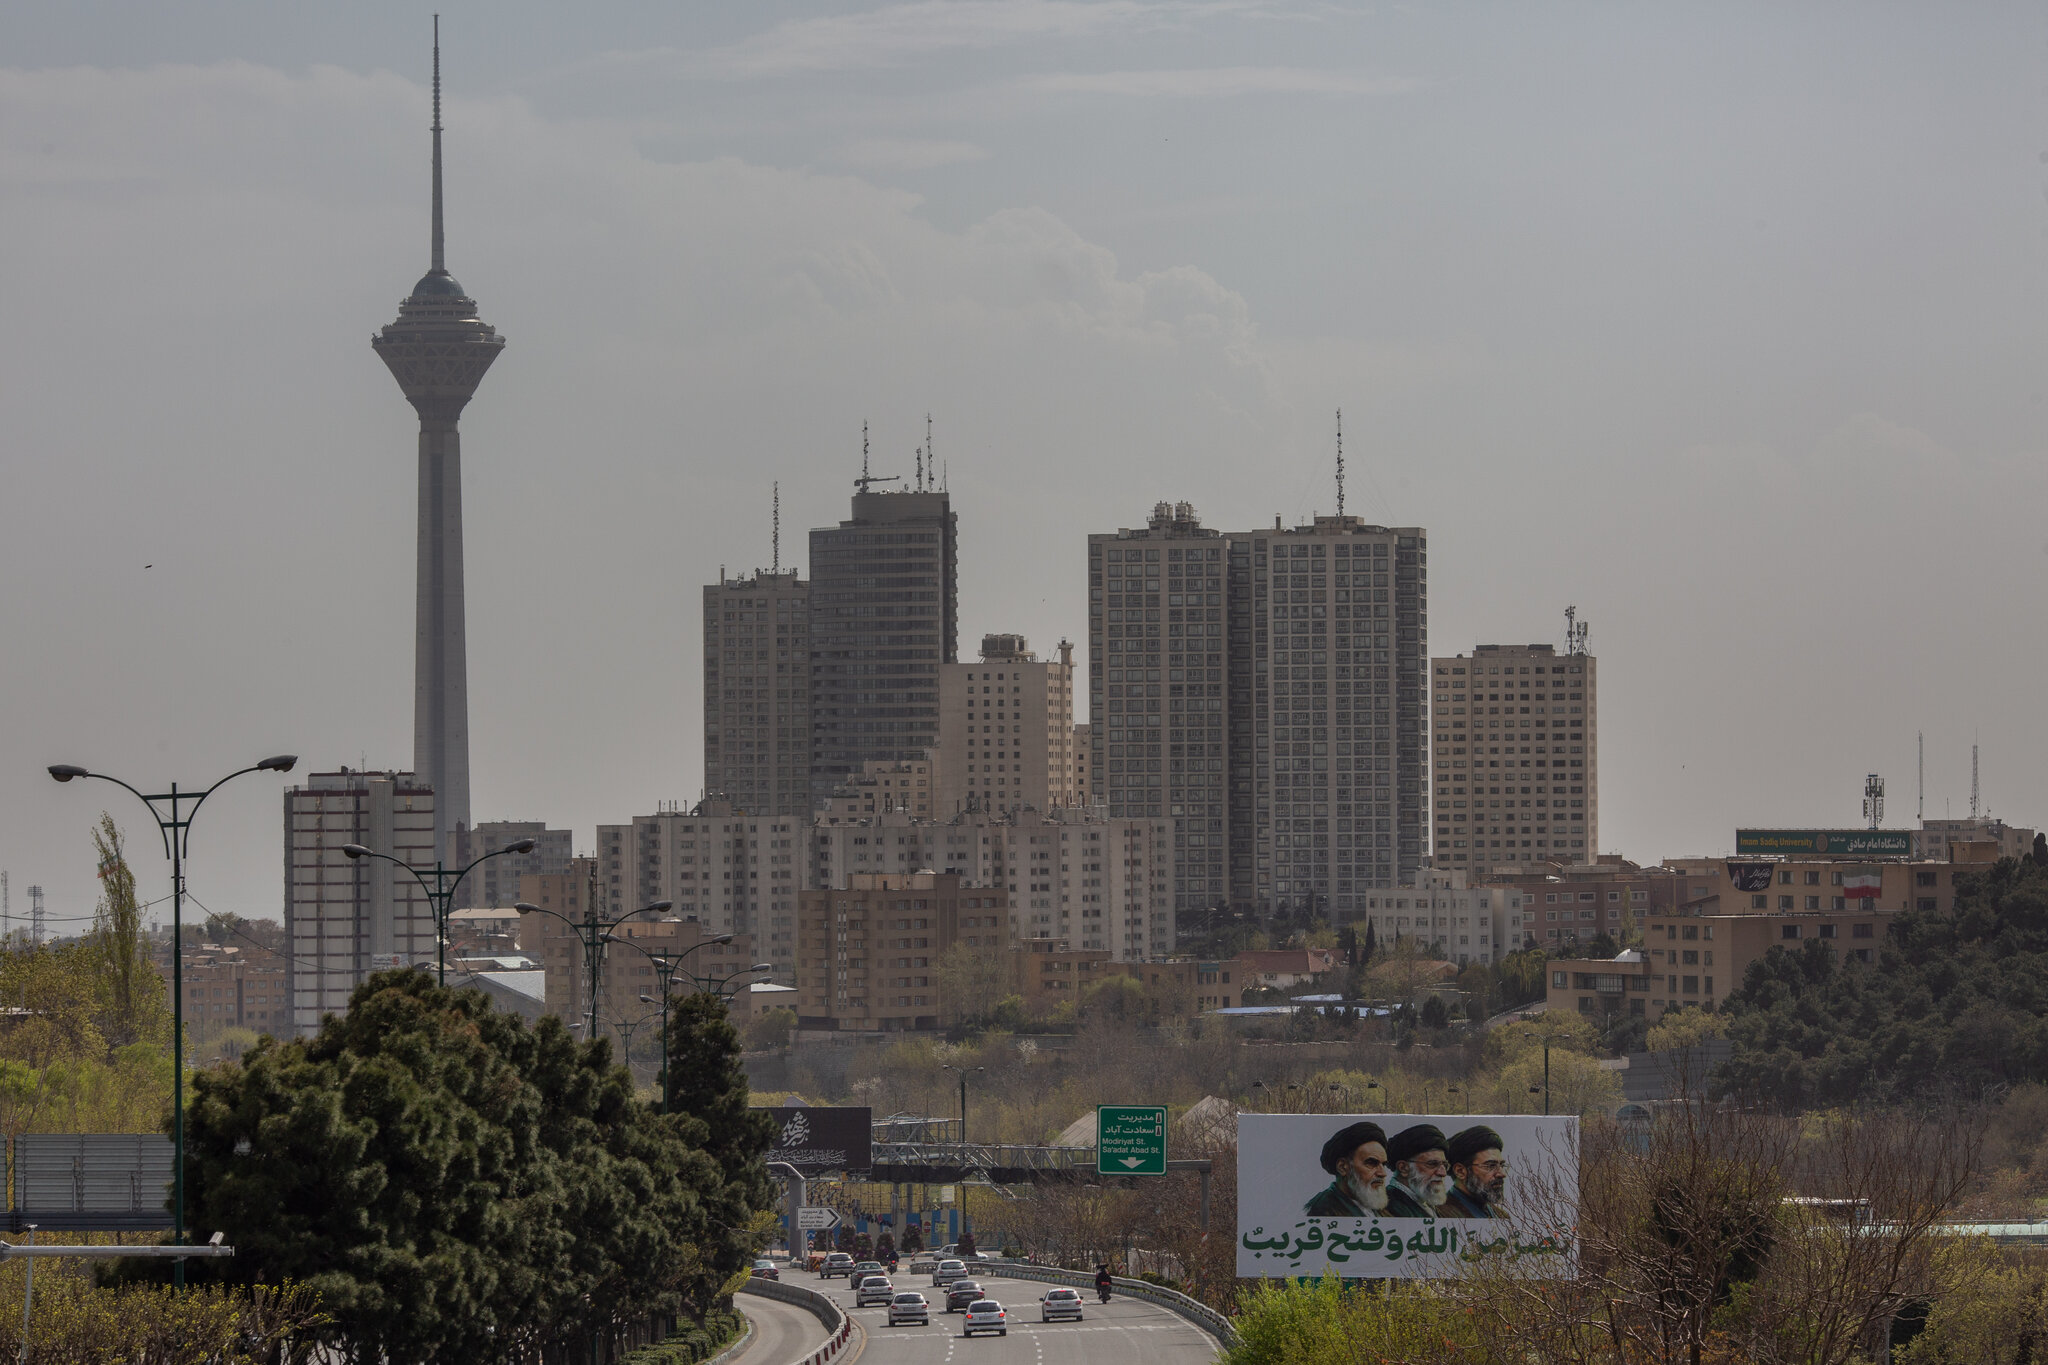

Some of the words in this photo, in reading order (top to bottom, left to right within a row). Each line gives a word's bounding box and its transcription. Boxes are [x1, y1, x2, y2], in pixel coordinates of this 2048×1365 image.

[1760, 837, 1779, 849] Sadiq
[1780, 837, 1813, 849] University
[1847, 837, 1866, 852] صادق
[1866, 837, 1880, 852] امام
[1881, 837, 1907, 849] دانشگاه
[1117, 1114, 1154, 1123] مدیریت
[1105, 1125, 1122, 1136] آباد
[1122, 1126, 1154, 1134] سعادت
[1102, 1137, 1134, 1146] Modiriyat
[1136, 1137, 1146, 1145] St.
[1102, 1146, 1129, 1154] Sa'adat
[1130, 1146, 1149, 1154] Abad
[1150, 1146, 1161, 1154] St.
